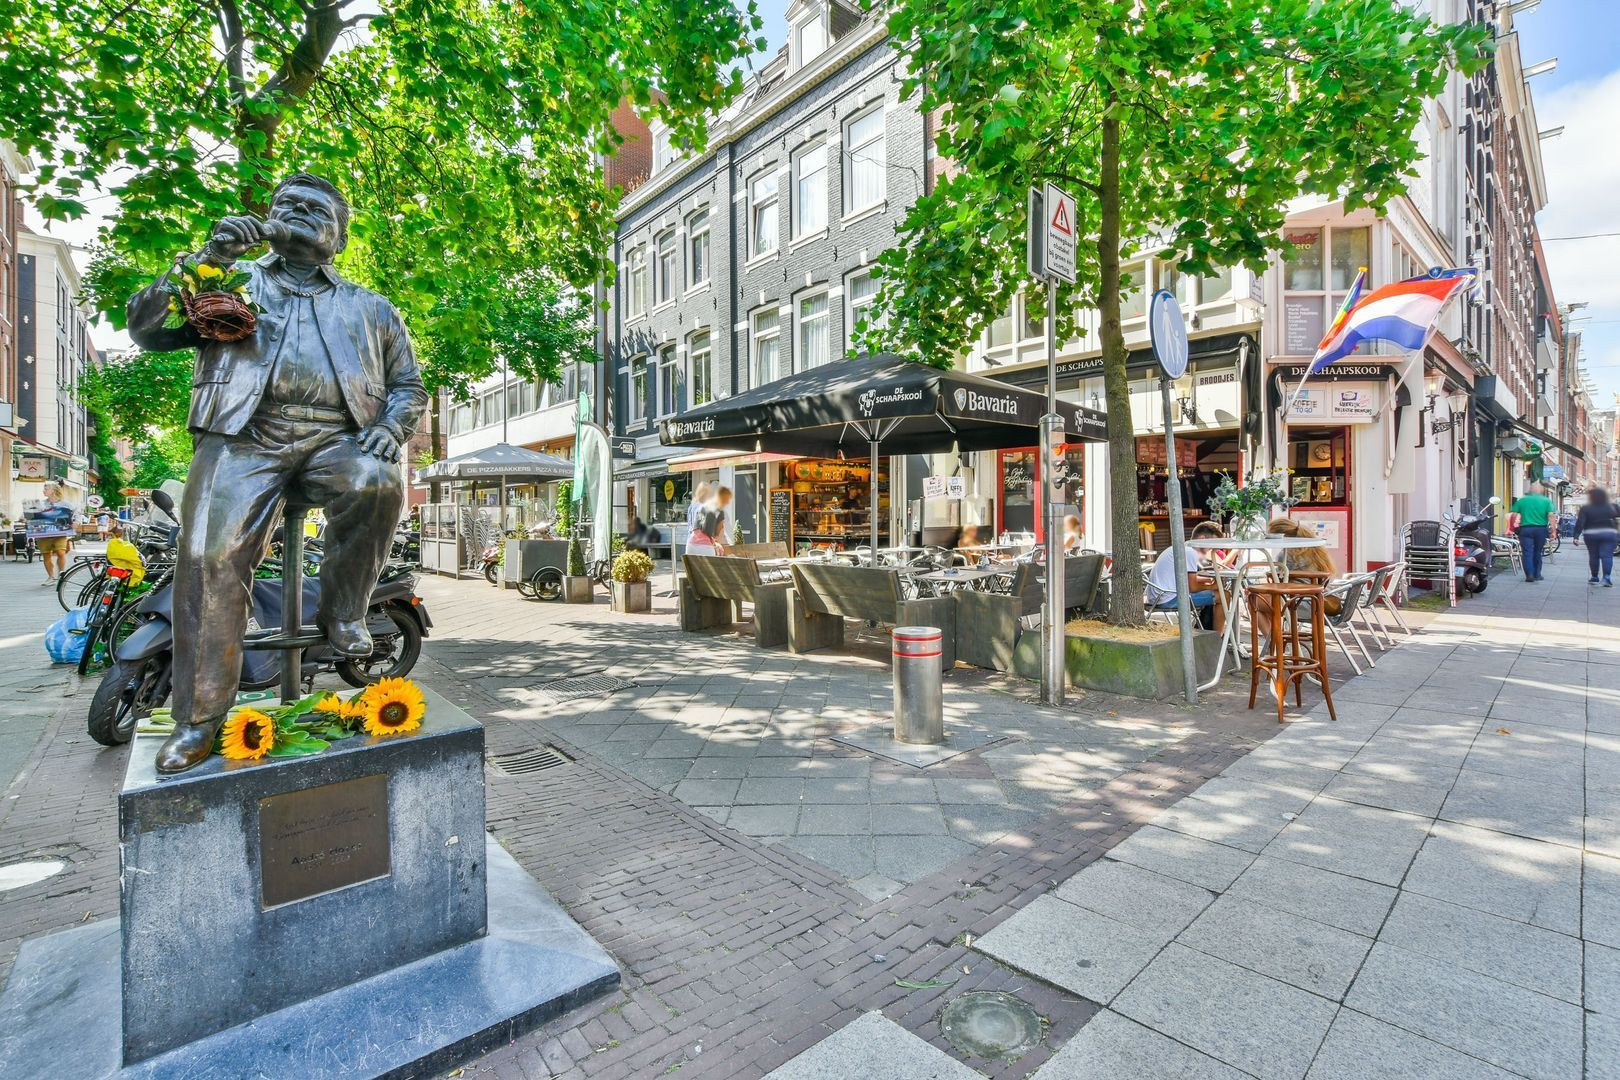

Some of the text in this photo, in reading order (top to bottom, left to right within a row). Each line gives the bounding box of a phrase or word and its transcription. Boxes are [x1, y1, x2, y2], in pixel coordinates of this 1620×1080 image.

[1056, 365, 1067, 373] DE
[1292, 367, 1306, 375] DE
[1200, 373, 1234, 386] BROODJES
[968, 391, 1018, 415] Bavaria
[677, 416, 715, 437] Bavaria
